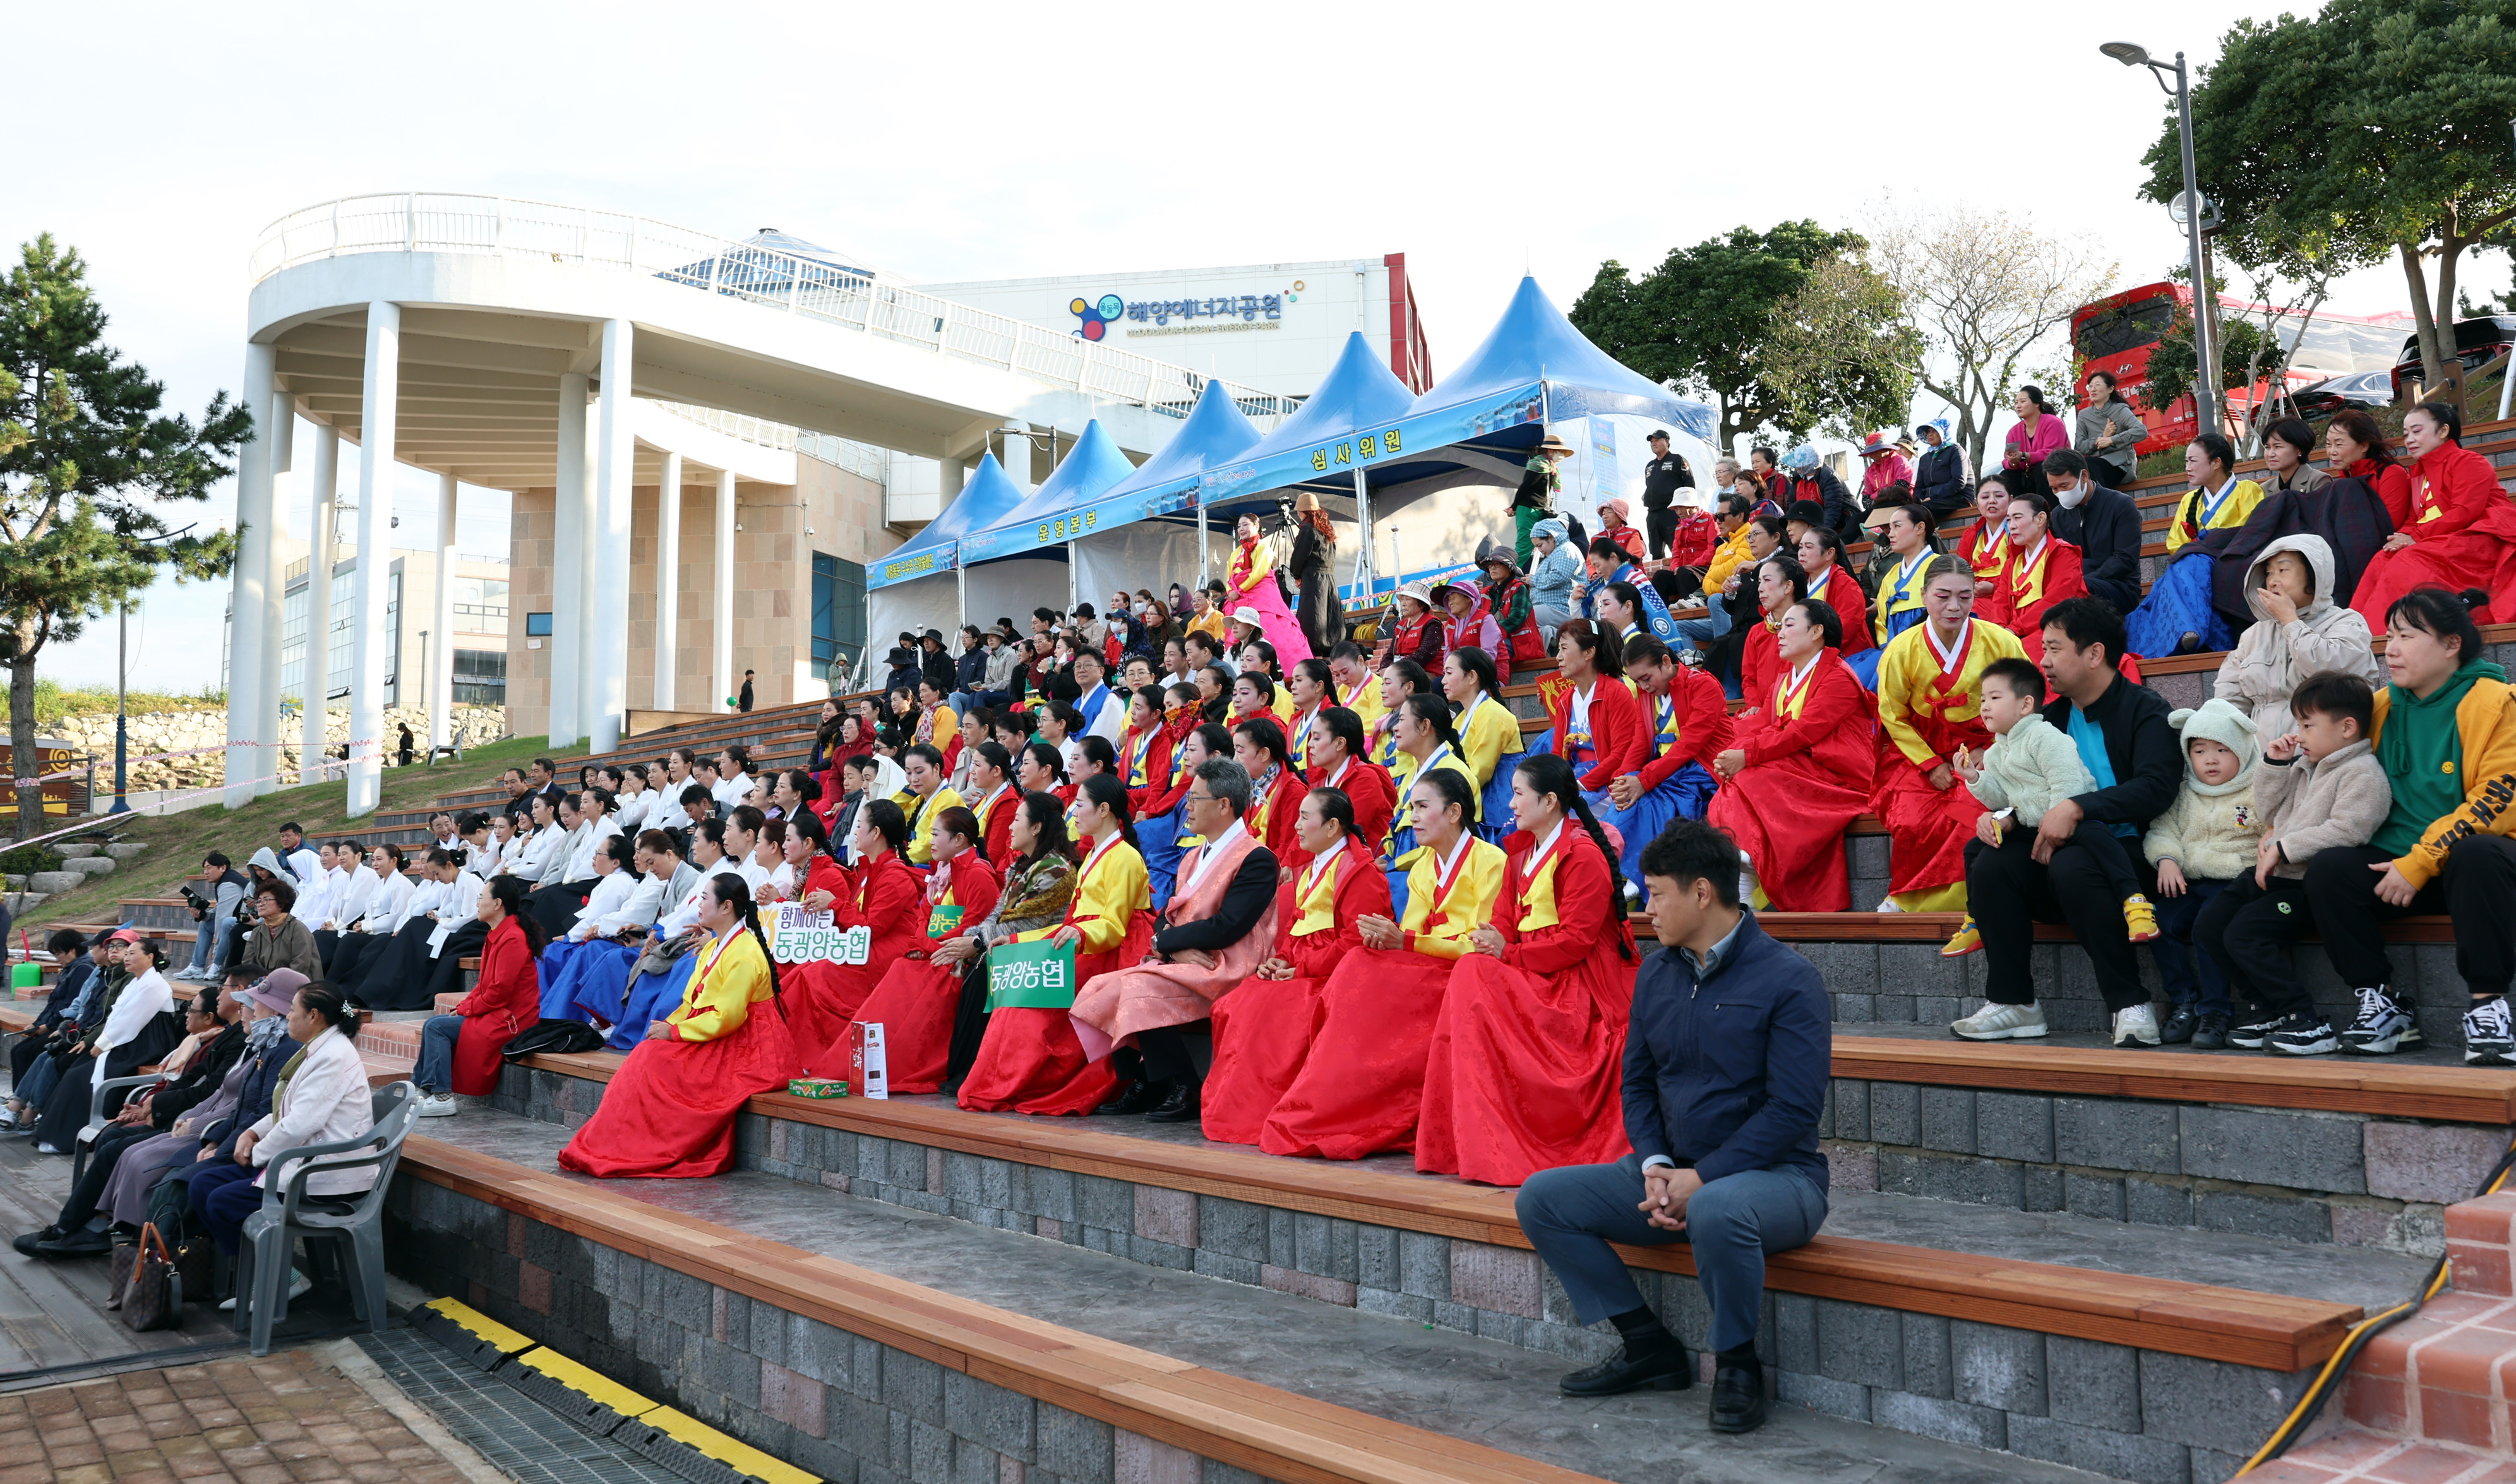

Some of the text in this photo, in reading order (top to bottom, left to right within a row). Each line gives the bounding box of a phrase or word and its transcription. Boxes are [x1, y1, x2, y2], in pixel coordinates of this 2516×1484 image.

[1099, 302, 1120, 314] 울돌목
[1127, 294, 1281, 326] 해양에너지공원
[1127, 320, 1281, 338] ULDOLMOK OCEAN ENERGY PARK
[1311, 429, 1401, 471] 심사위원
[1038, 510, 1096, 542] 운영본부
[781, 906, 830, 930] 함께하는
[776, 931, 867, 959] 동광양농협
[991, 959, 1065, 992] 동광양농협
